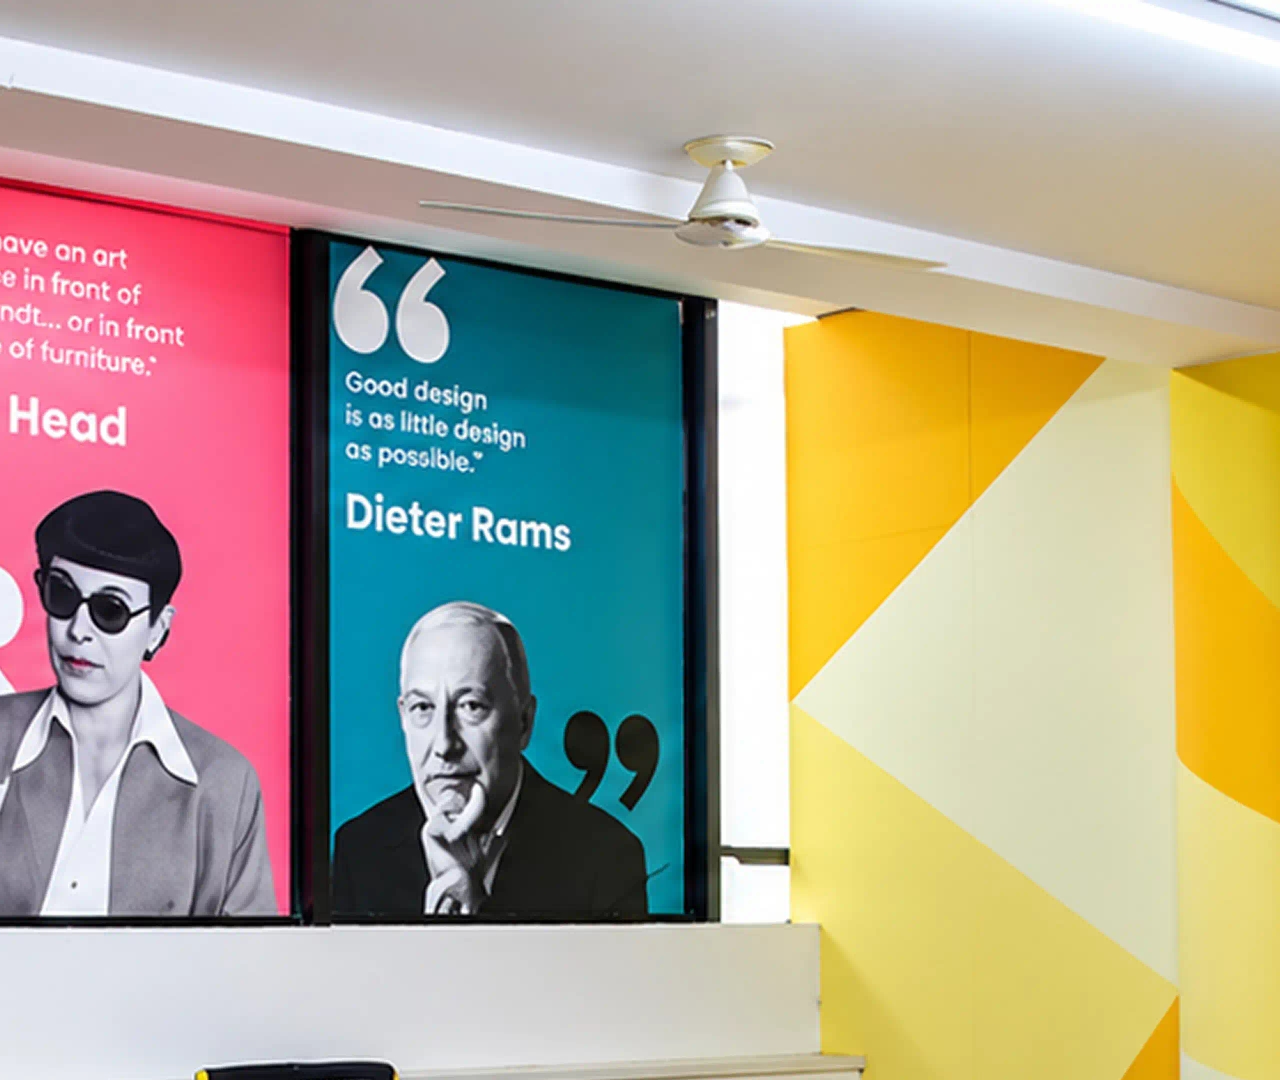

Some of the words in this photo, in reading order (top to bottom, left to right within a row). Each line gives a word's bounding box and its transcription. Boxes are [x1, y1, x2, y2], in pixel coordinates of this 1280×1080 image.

[55, 241, 86, 264] an
[93, 247, 128, 269] art
[23, 268, 44, 293] in
[51, 273, 110, 302] front
[117, 284, 142, 305] of
[9, 336, 35, 359] of
[68, 313, 92, 333] or
[99, 313, 119, 337] in
[126, 317, 184, 346] front
[345, 370, 407, 399] Good
[414, 380, 487, 414] design
[9, 394, 127, 447] Head
[345, 403, 362, 427] is
[368, 411, 394, 430] as
[401, 411, 448, 436] little
[453, 419, 526, 452] design
[345, 441, 371, 460] as
[346, 493, 462, 539] Dieter
[472, 507, 571, 551] Rams
